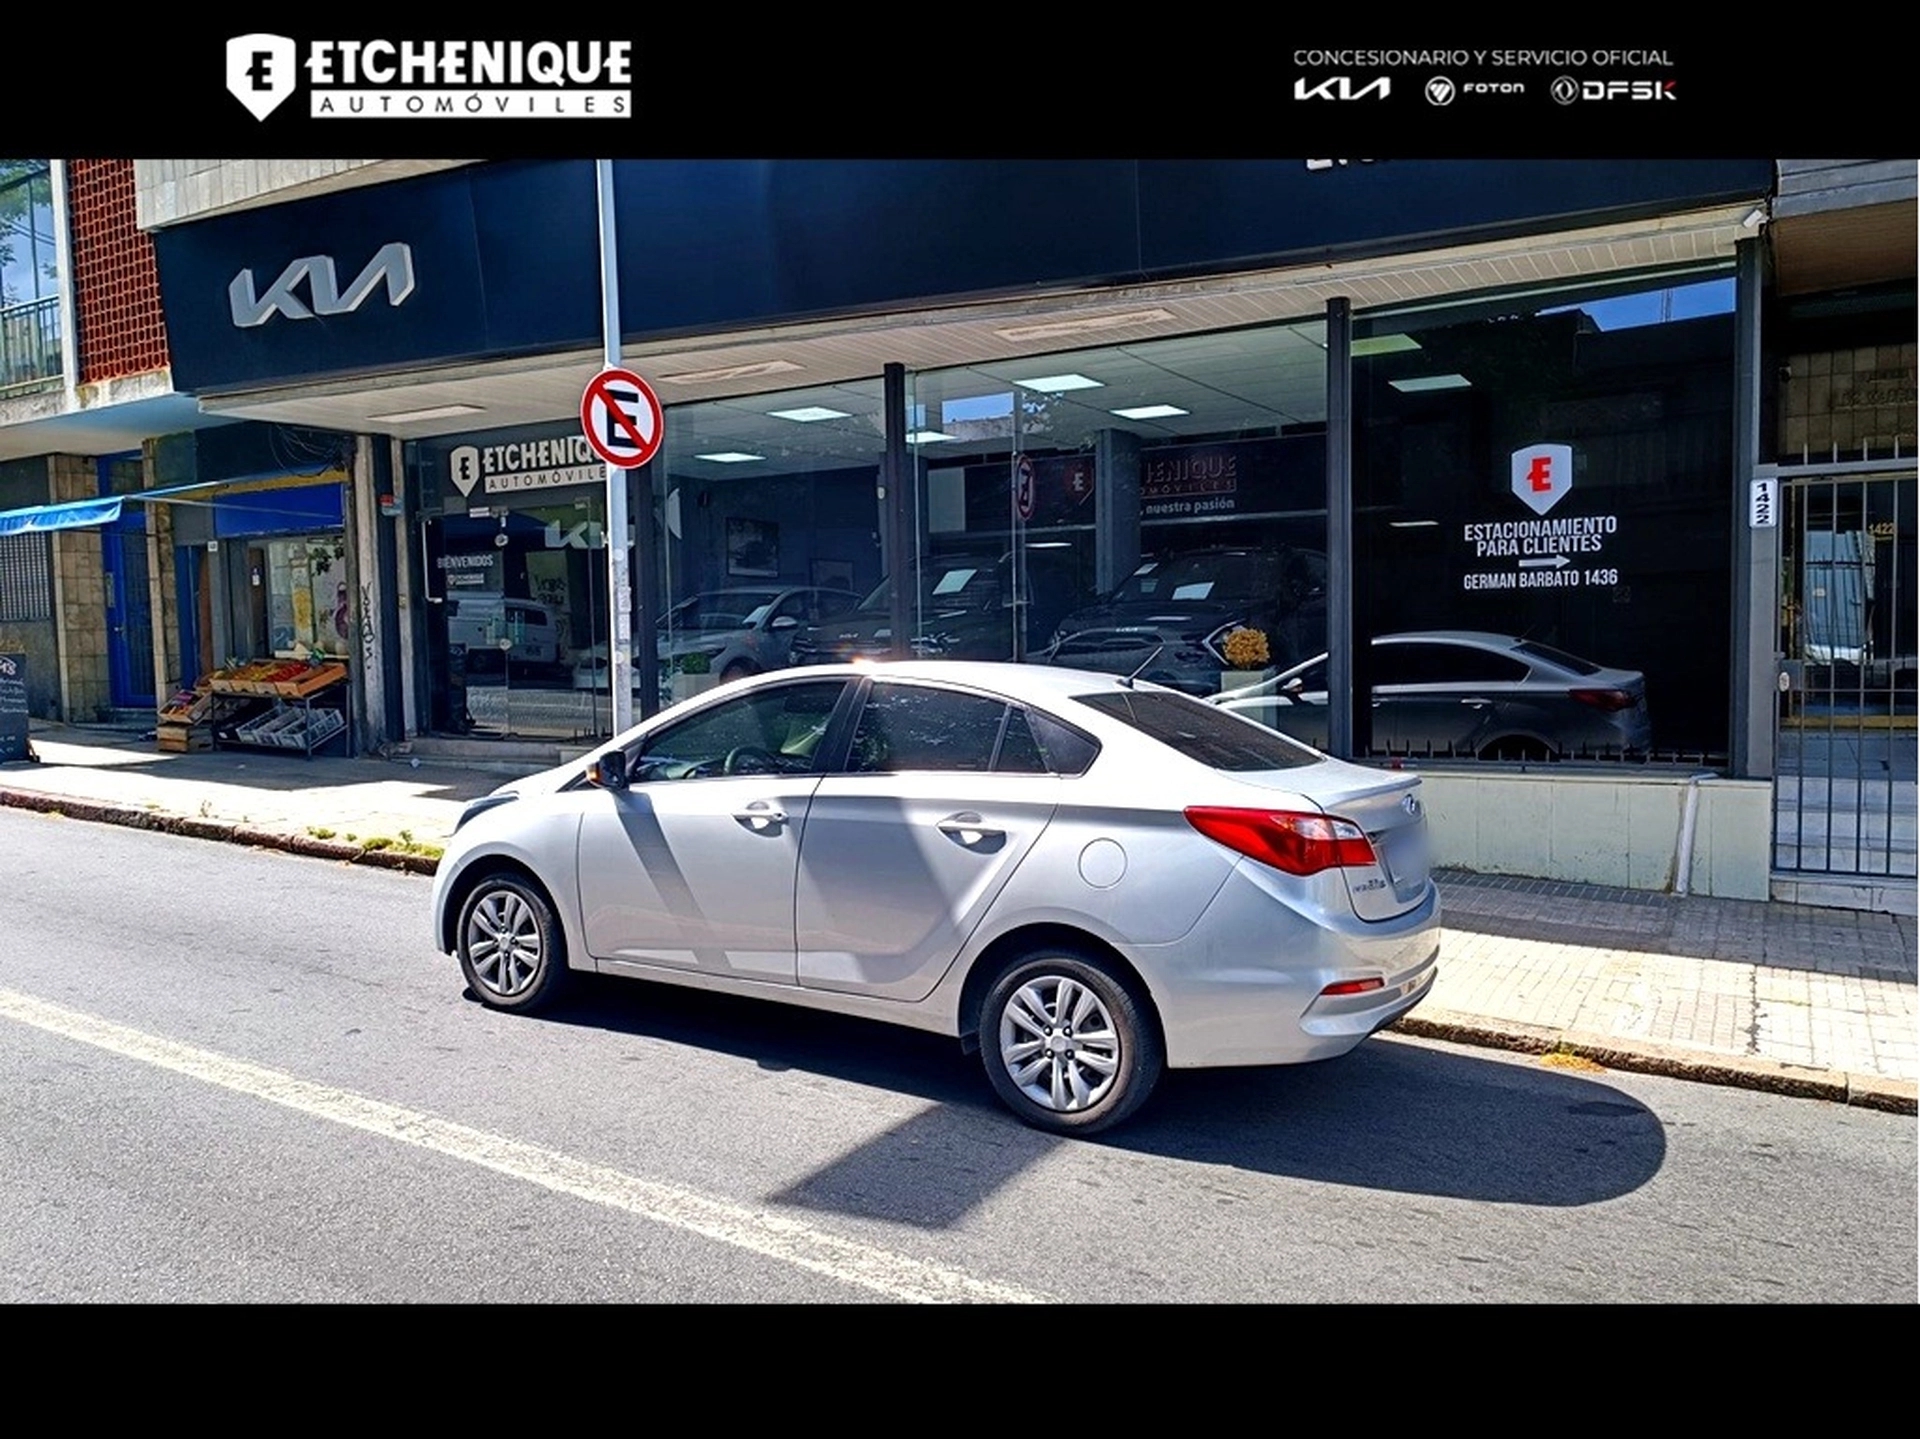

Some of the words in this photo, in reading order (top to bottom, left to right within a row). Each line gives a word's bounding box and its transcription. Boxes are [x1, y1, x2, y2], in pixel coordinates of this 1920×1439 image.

[228, 241, 415, 328] KIA
[482, 434, 604, 474] ETCHENIQ
[488, 464, 607, 490] AUTOMÓVILE
[1526, 456, 1552, 493] E
[1145, 501, 1192, 515] nuestra
[1194, 497, 1236, 514] pasión
[1755, 482, 1771, 525] 1422
[1464, 515, 1618, 541] ESTACIONAMIENTO
[1476, 538, 1520, 557] PARA
[1522, 533, 1603, 555] CLIENTES
[1463, 572, 1517, 590] GERMAN
[1518, 569, 1580, 588] BARBATO
[1584, 568, 1619, 587] 1436
